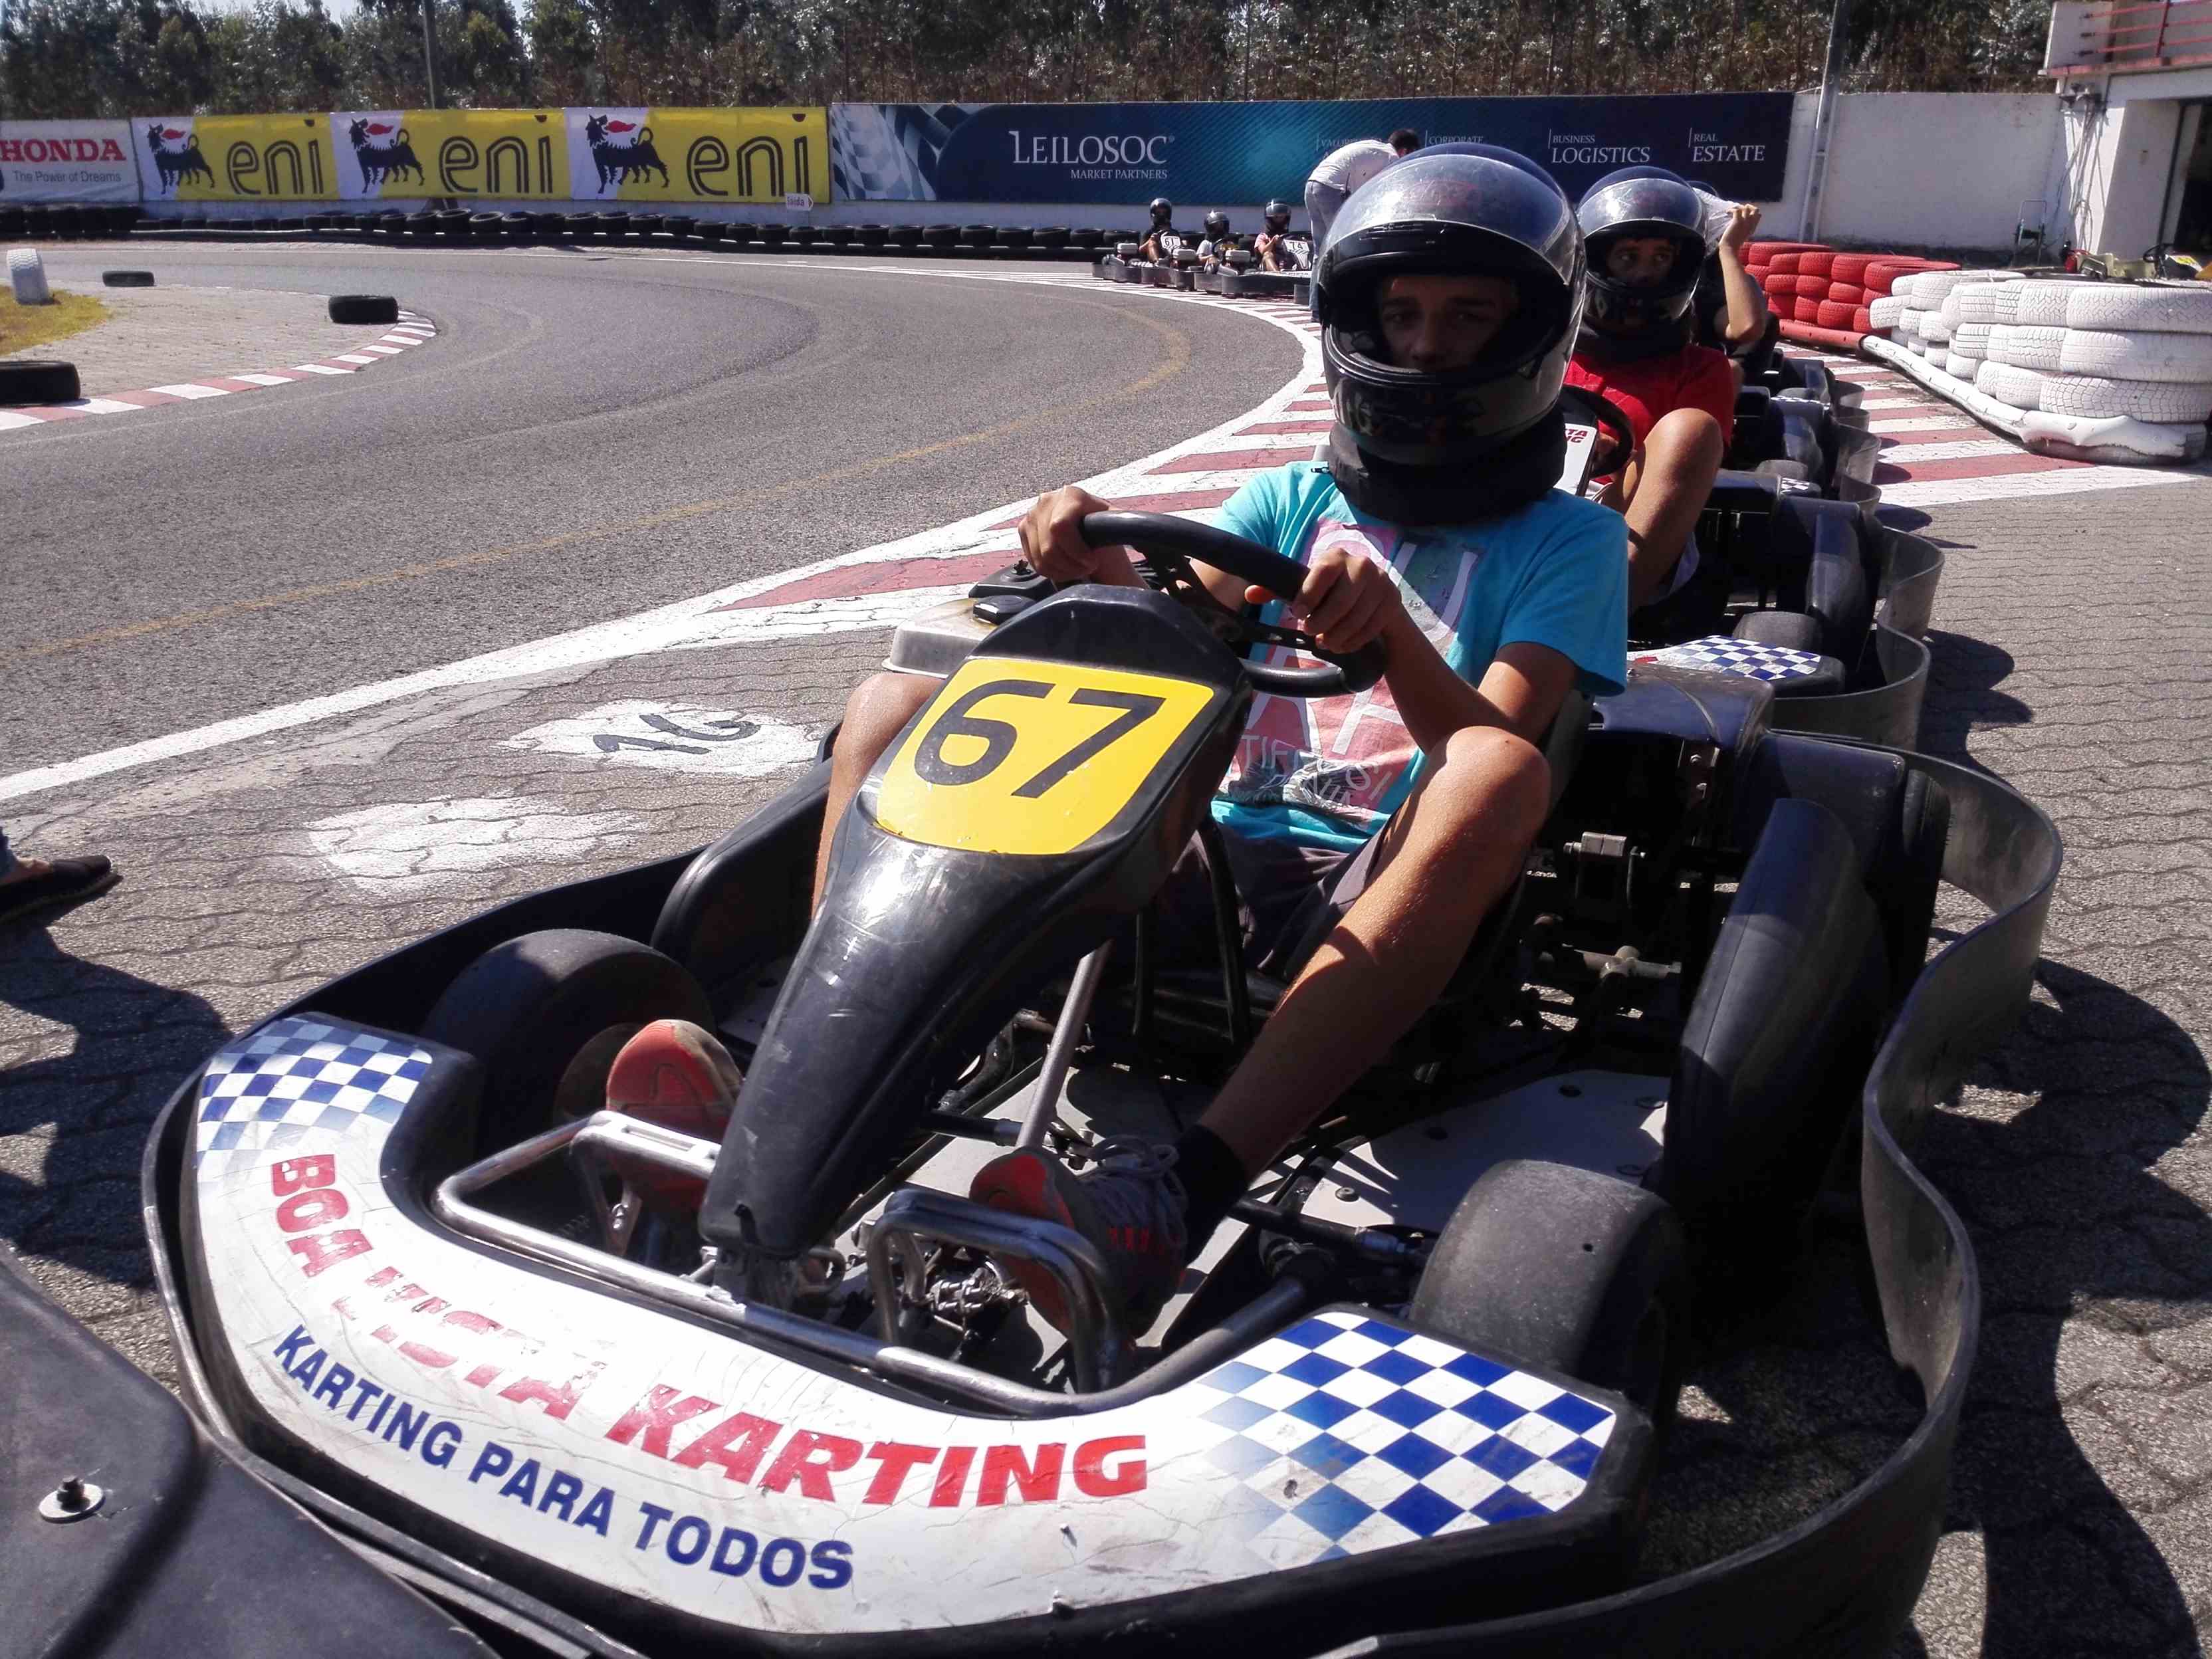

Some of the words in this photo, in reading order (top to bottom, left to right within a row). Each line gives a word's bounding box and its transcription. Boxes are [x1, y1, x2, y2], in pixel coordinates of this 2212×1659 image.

[1429, 136, 1484, 145] CORPORATE
[1553, 135, 1595, 144] BUSINESS
[1694, 133, 1718, 142] REAL
[0, 138, 127, 162] HONDA
[227, 119, 324, 195] eni
[439, 115, 553, 194] eni
[687, 114, 810, 197] eni
[1551, 146, 1650, 164] LOGISTICS
[1692, 145, 1766, 162] ESTATE
[13, 170, 33, 181] The
[35, 170, 67, 182] Power
[68, 170, 78, 181] of
[80, 170, 122, 182] Dreams
[1070, 169, 1113, 179] MARKET
[1115, 169, 1168, 179] PARTNERS
[914, 679, 1166, 799] 67
[604, 1383, 1148, 1509] KARTING
[273, 1325, 463, 1470] KARTING
[467, 1440, 615, 1537] PARA
[635, 1501, 854, 1589] TODOS
